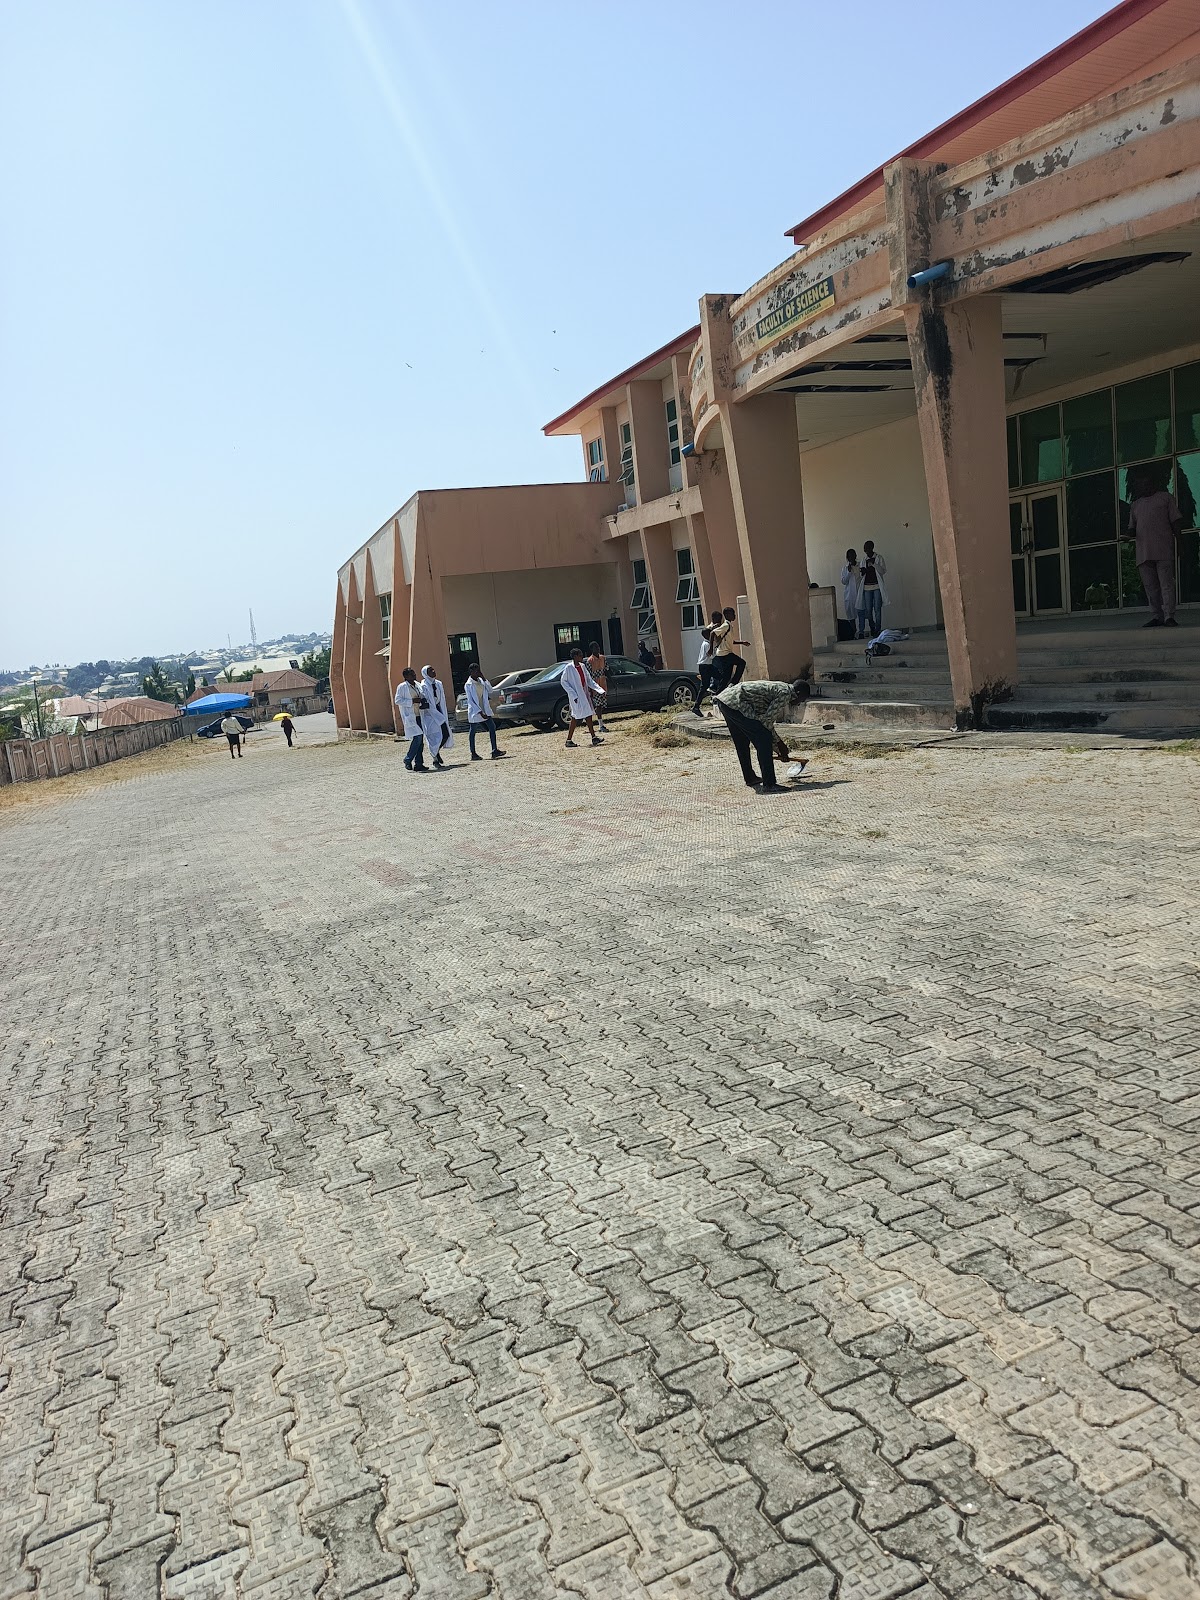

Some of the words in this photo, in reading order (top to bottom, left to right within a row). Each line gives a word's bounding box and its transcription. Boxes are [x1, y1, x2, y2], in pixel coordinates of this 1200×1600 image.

[759, 308, 784, 337] FACULTY
[786, 301, 795, 318] OF
[797, 281, 829, 313] SCIENCE
